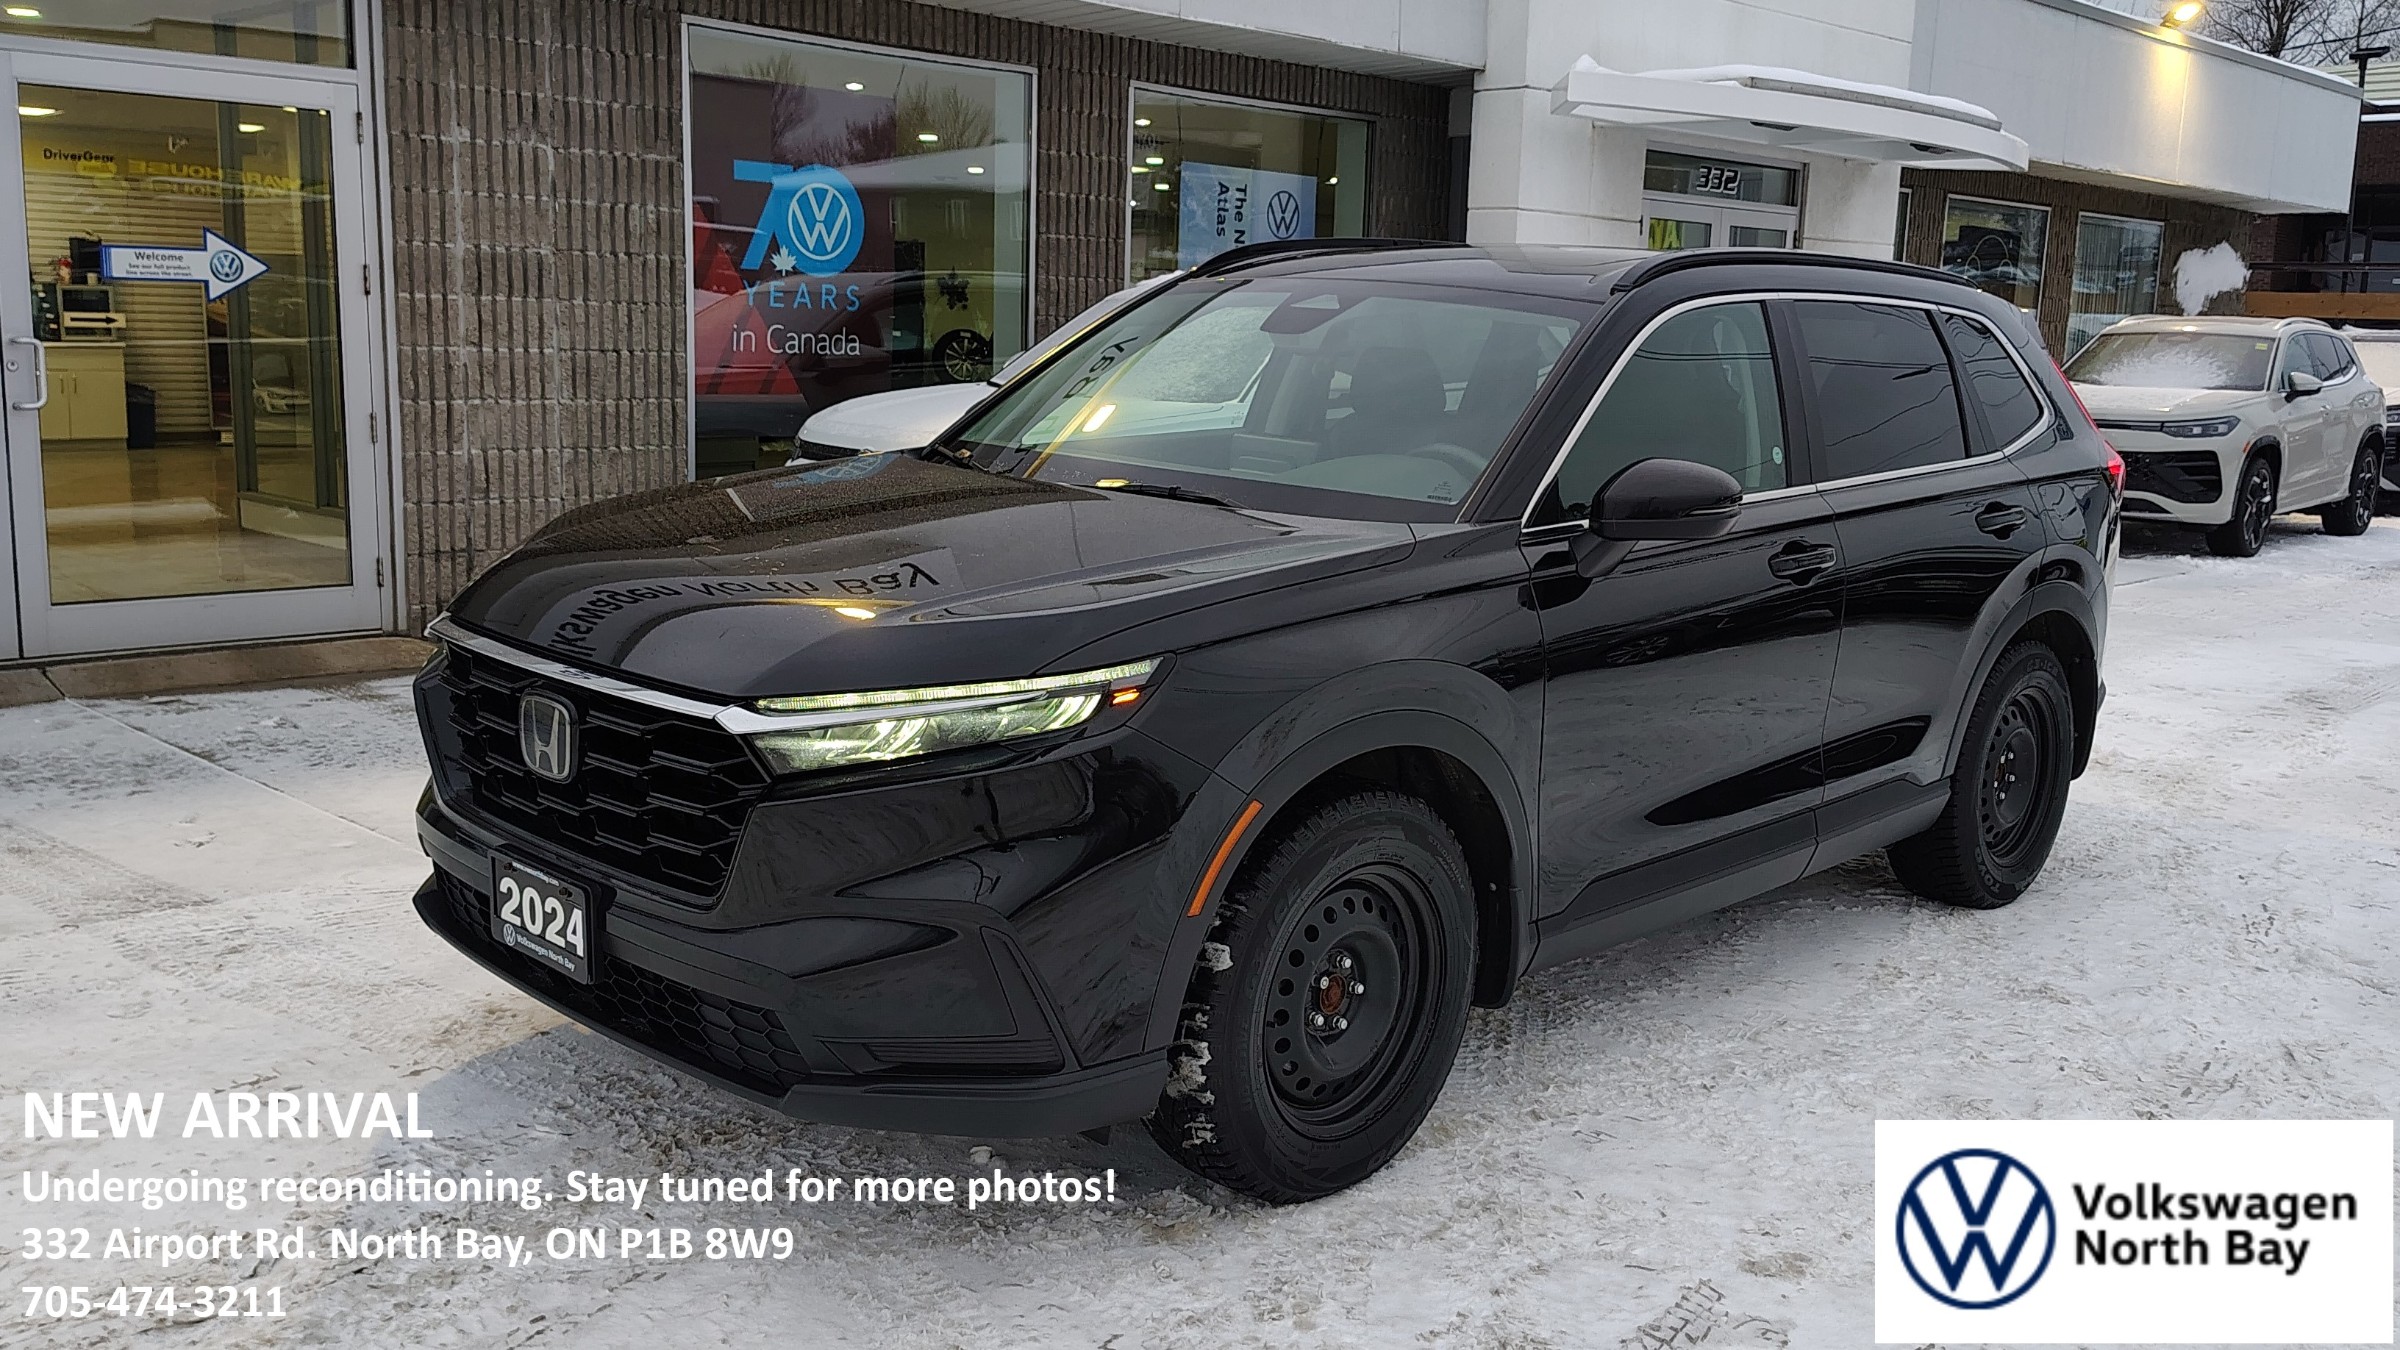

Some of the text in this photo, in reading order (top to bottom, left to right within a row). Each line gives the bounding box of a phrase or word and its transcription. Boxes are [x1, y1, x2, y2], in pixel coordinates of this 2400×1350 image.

[1696, 164, 1741, 195] 332
[1216, 181, 1231, 237] Atlas
[1234, 184, 1248, 223] The
[134, 251, 184, 263] Welcome
[745, 280, 861, 312] YEARS
[732, 325, 861, 356] in Canada
[500, 877, 584, 957] 2024
[516, 933, 576, 972] Volkswagen North Bay
